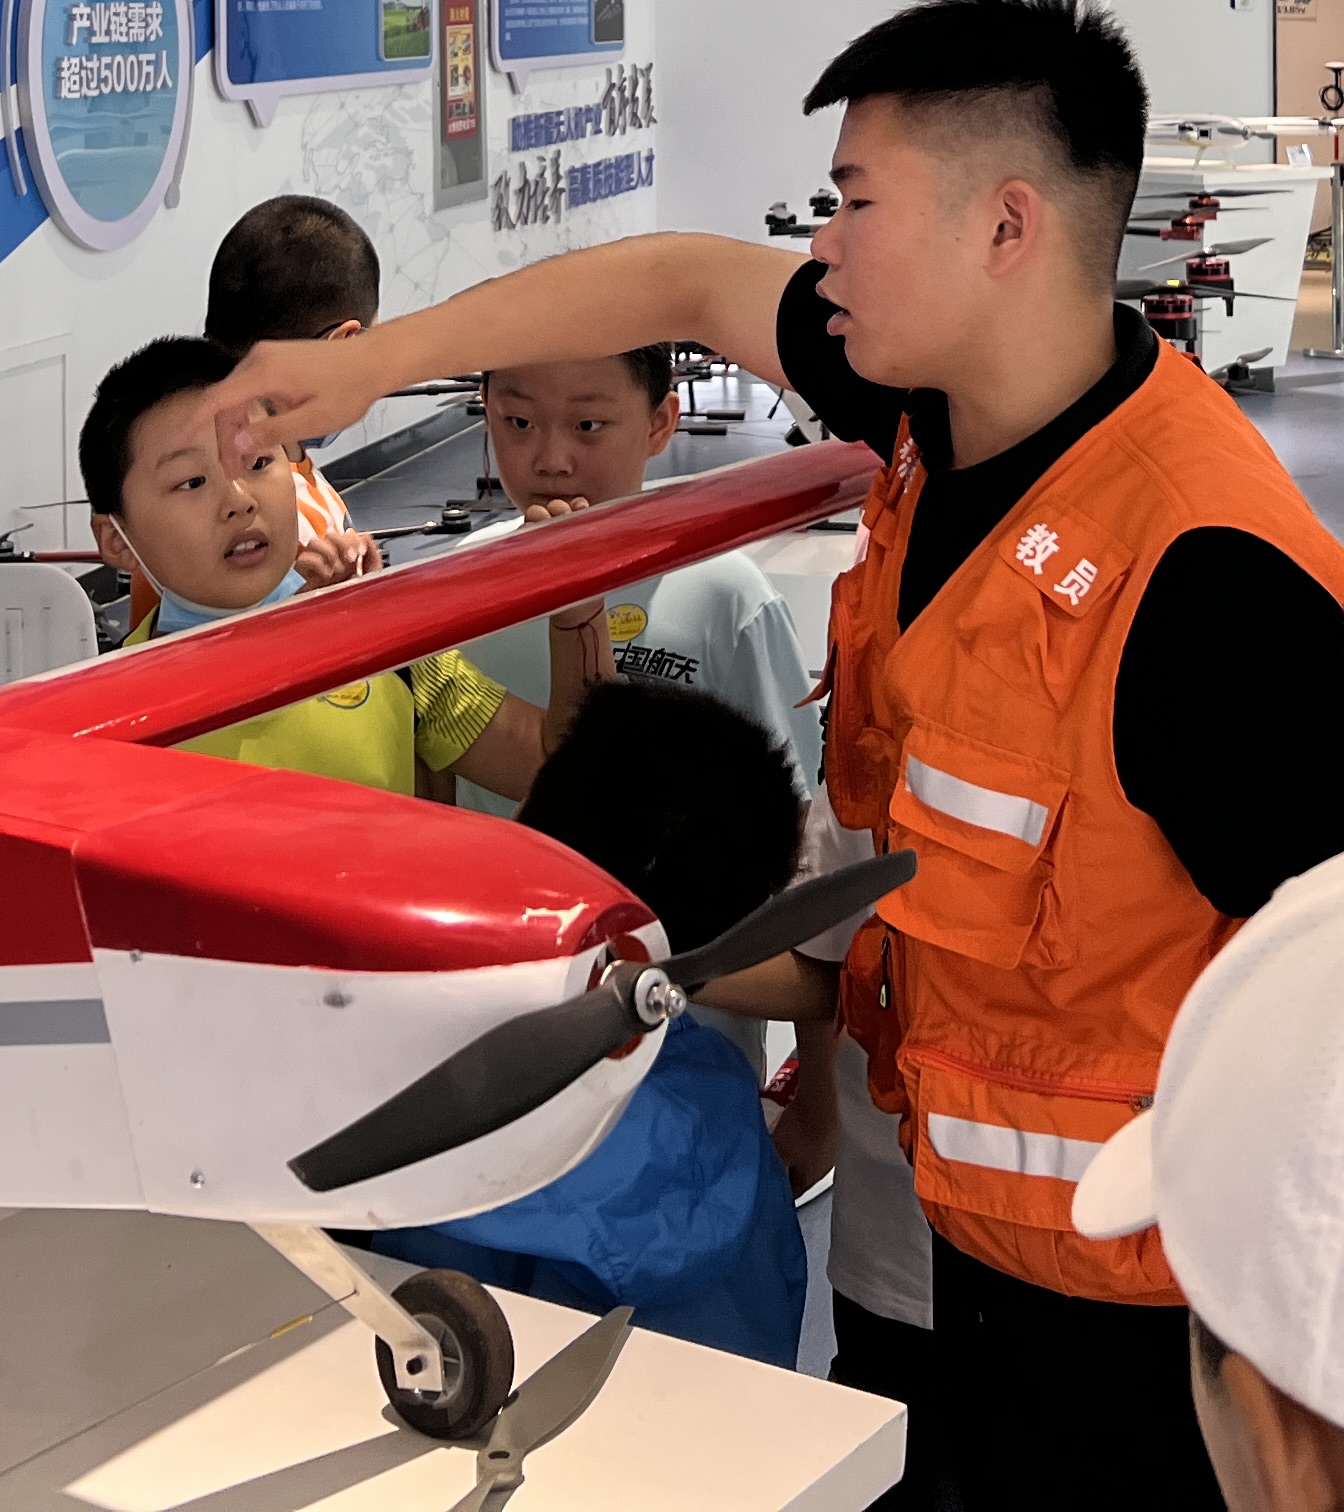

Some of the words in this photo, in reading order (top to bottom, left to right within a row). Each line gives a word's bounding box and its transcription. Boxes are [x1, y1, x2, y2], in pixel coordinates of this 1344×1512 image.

[70, 1, 164, 46] 产业链需求
[60, 50, 173, 100] 超过500万人
[1015, 522, 1099, 606] 教员
